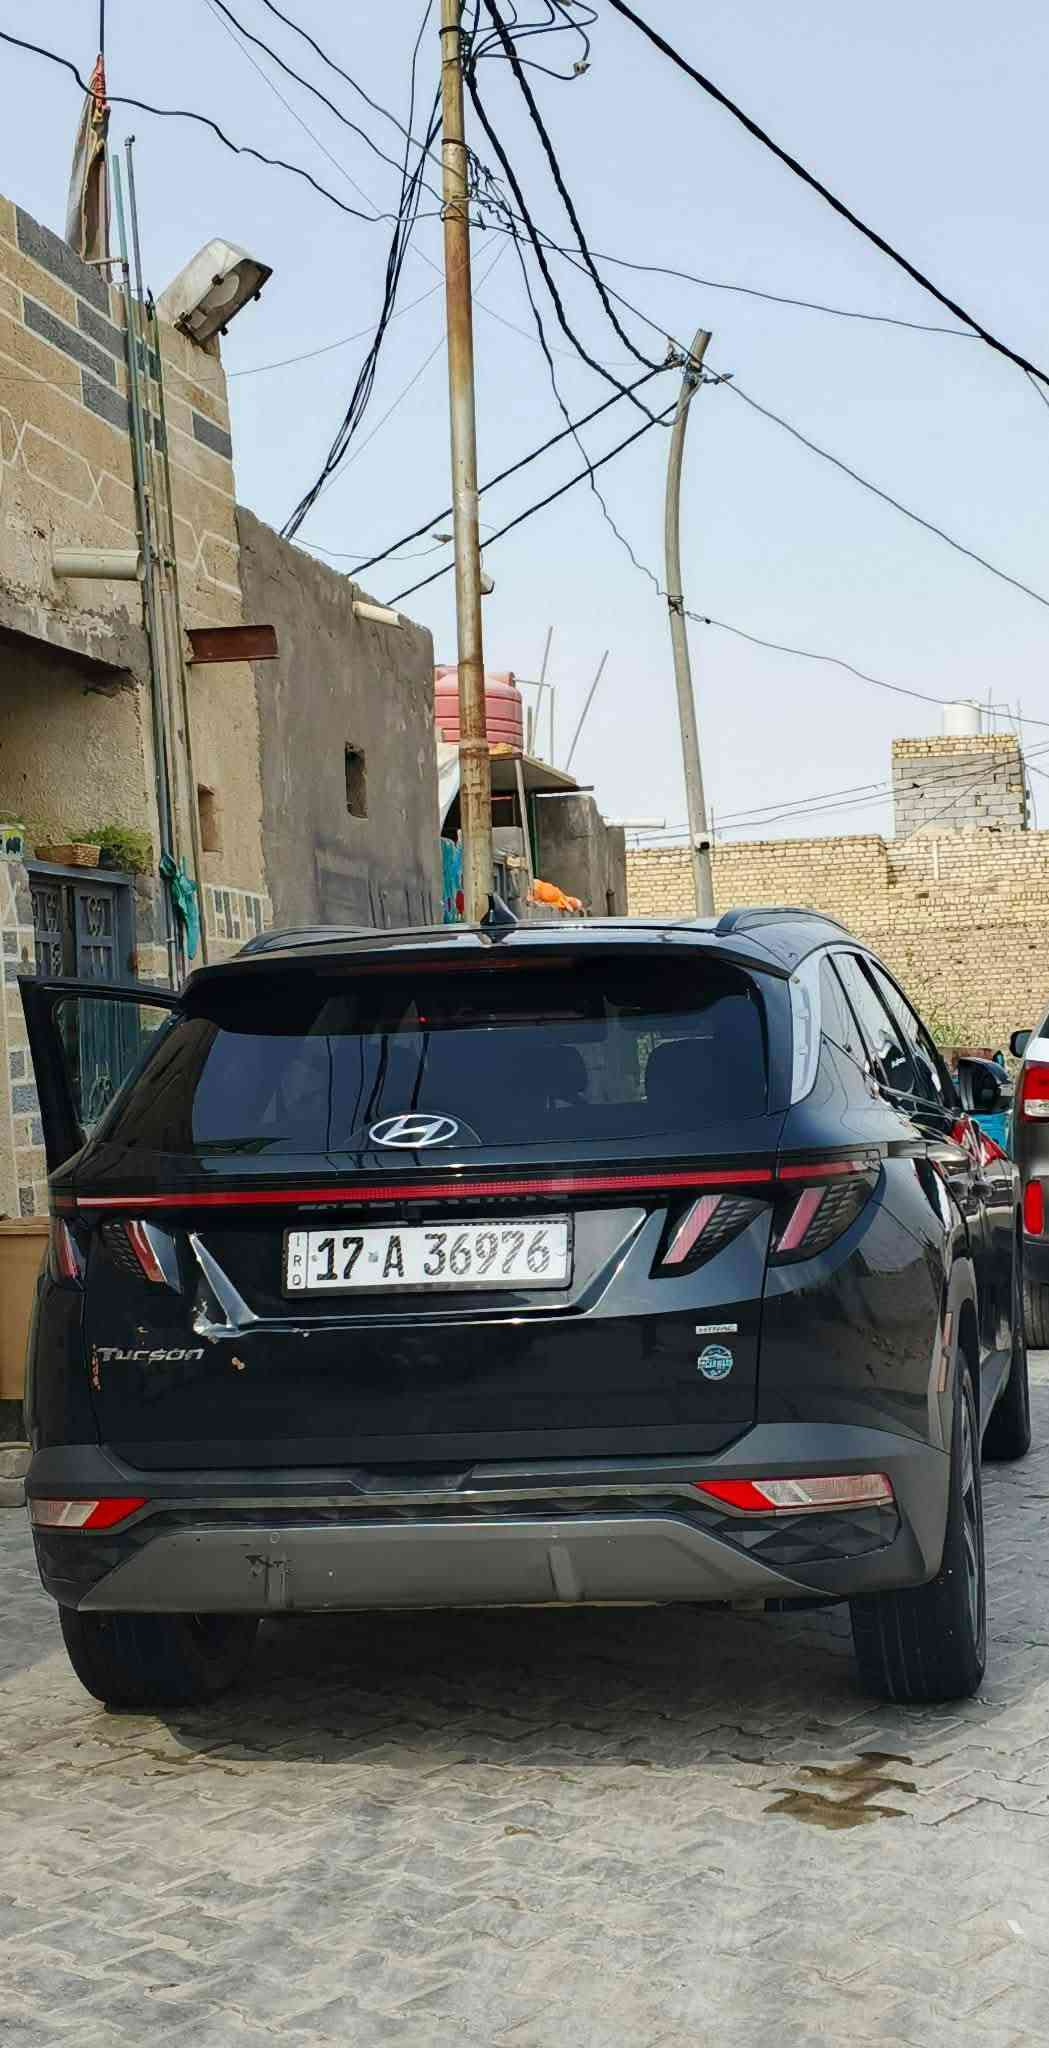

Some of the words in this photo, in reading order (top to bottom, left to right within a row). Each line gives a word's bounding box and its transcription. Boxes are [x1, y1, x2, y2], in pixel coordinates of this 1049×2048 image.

[316, 1237, 364, 1281] 17
[382, 1234, 405, 1278] A
[423, 1230, 550, 1276] 36976
[98, 1347, 205, 1362] Tucson
